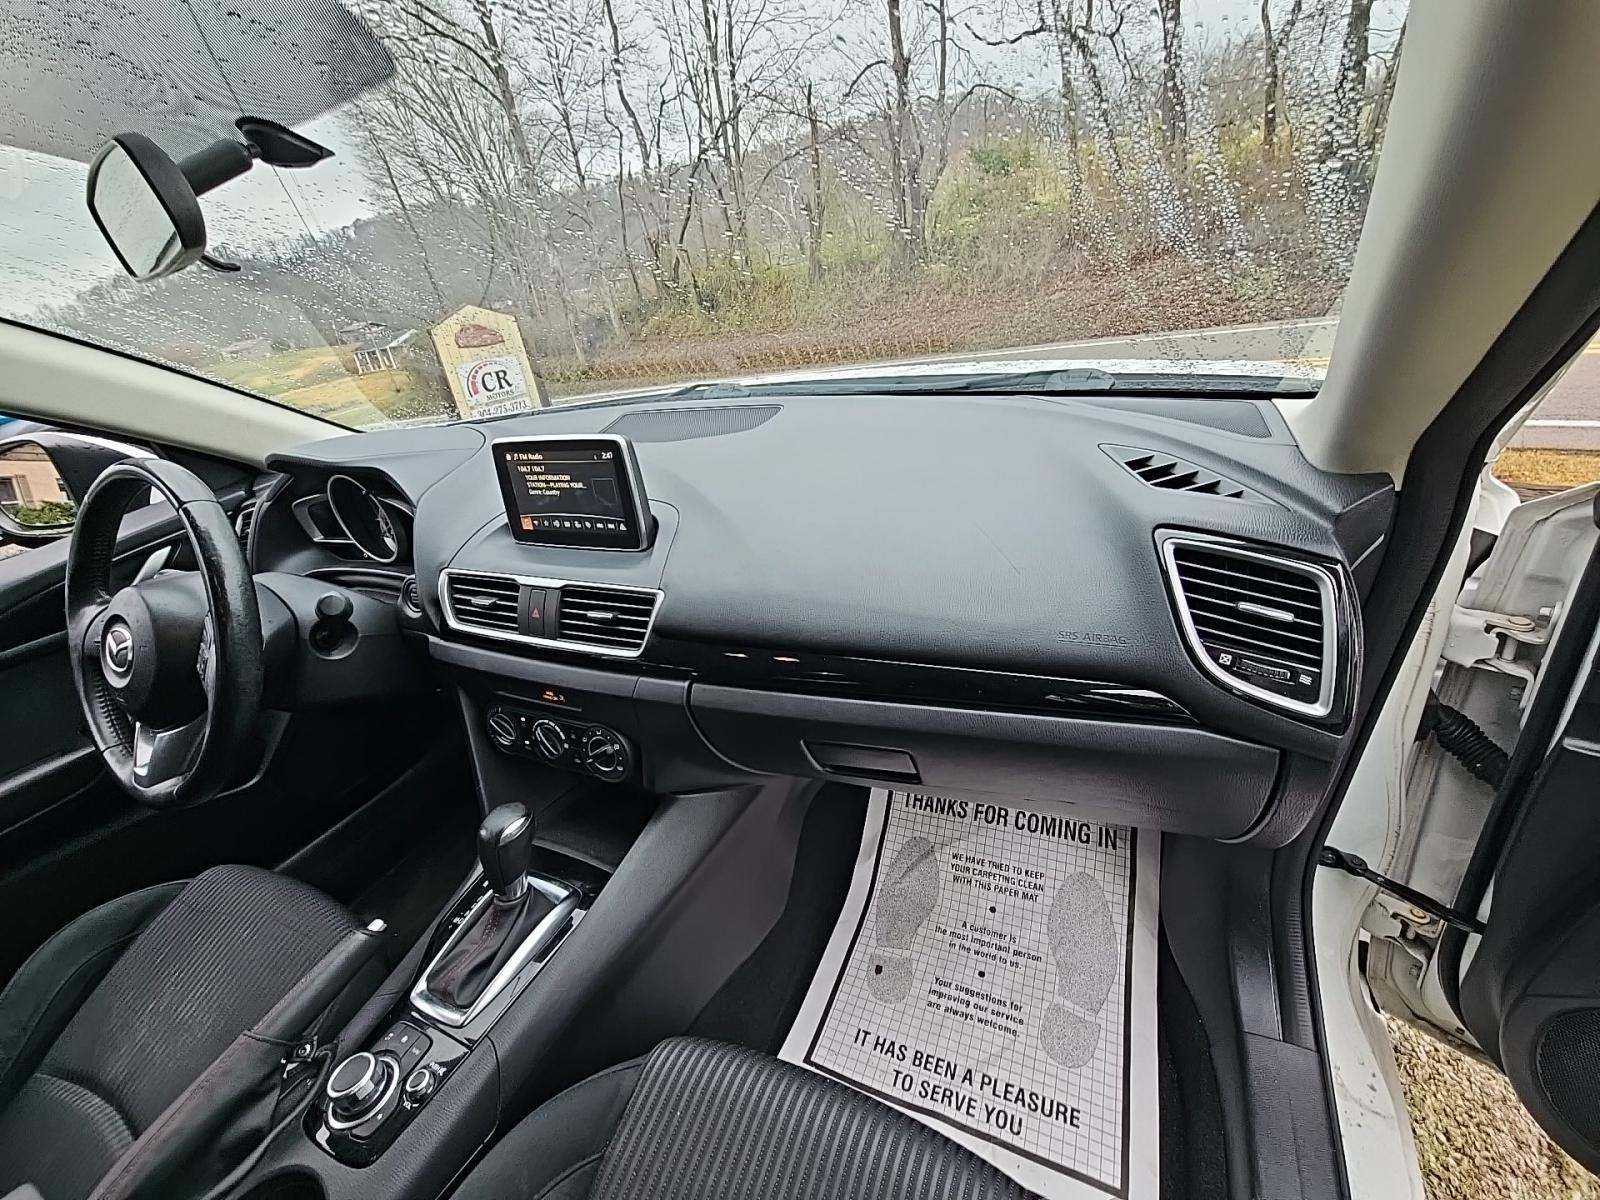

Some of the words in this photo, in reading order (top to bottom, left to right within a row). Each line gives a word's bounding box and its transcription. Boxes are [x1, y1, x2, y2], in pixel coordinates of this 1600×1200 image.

[481, 369, 512, 392] CR
[486, 389, 514, 401] MOTORS
[1058, 630, 1079, 641] SRS
[1083, 632, 1127, 645] AIRBAG
[905, 792, 968, 818] THANKS
[973, 803, 1009, 827] FOR
[1014, 810, 1091, 845] COMING
[1098, 827, 1118, 850] IN
[950, 862, 971, 875] YOUR
[972, 867, 1016, 886] CARPETING
[1018, 879, 1044, 892] CLEAN
[952, 852, 964, 861] WE
[965, 855, 986, 867] HAVE
[988, 860, 1010, 872] TRIED
[1012, 865, 1023, 876] TO
[1024, 869, 1045, 880] KEEP
[952, 874, 972, 886] WITH
[974, 879, 992, 891] THIS
[993, 884, 1020, 898] PAPER
[1021, 891, 1039, 902] MAT
[935, 925, 947, 935] the
[949, 930, 969, 941] most
[970, 936, 1011, 954] important
[1012, 949, 1042, 963] person
[961, 920, 967, 929] A
[969, 924, 1007, 940] customer
[948, 941, 956, 949] in
[958, 943, 971, 953] the
[973, 949, 997, 961] world
[999, 955, 1007, 964] to
[1009, 960, 1022, 969] us.
[928, 987, 971, 1008] improving
[973, 1002, 988, 1013] our
[990, 1009, 1024, 1026] service
[934, 976, 952, 988] Your
[954, 983, 1008, 1008] suggestions
[1010, 1001, 1023, 1012] for
[927, 1000, 942, 1010] are
[944, 1004, 974, 1022] always
[976, 1016, 1020, 1038] welcome.
[854, 1028, 871, 1047] IT
[873, 1035, 908, 1062] HAS
[912, 1050, 957, 1081] BEEN
[961, 1068, 974, 1087] A
[979, 1072, 1081, 1129] PLEASURE
[892, 1068, 914, 1092] TO
[918, 1080, 978, 1117] SERVE
[984, 1103, 1023, 1136] YOU
